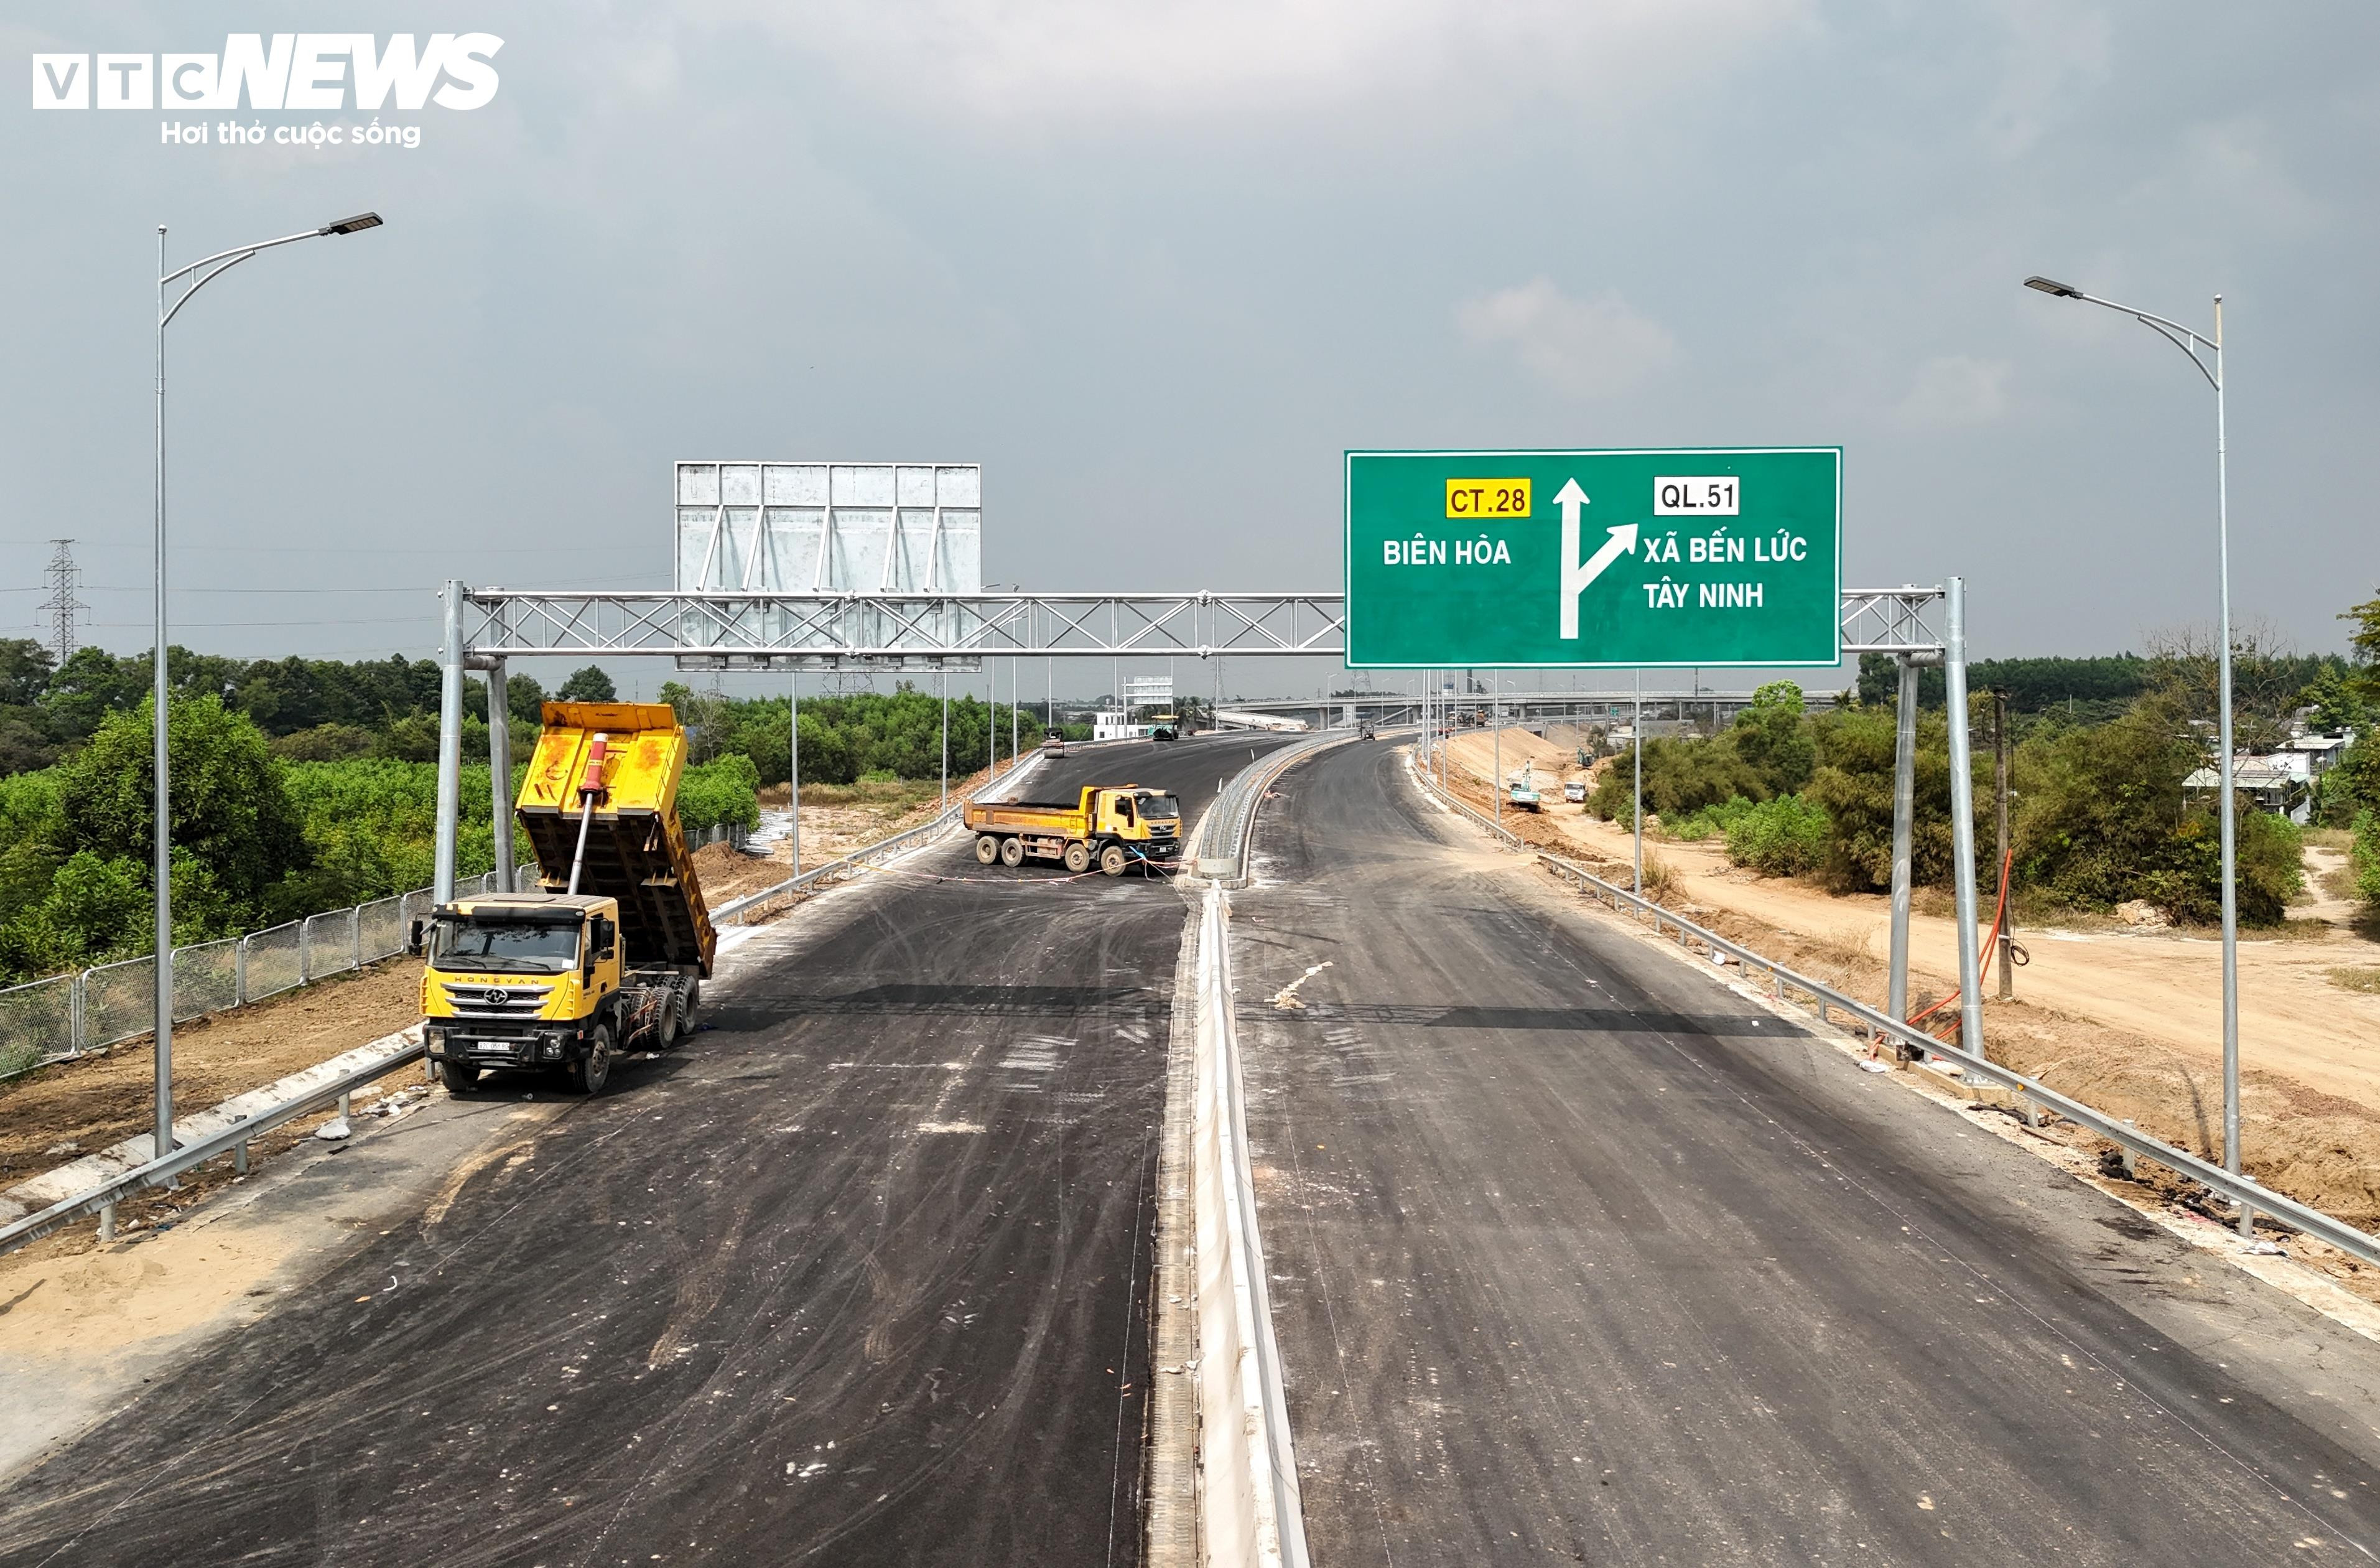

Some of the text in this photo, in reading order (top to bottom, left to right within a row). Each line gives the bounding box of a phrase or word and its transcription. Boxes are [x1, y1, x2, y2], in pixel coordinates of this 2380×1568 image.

[1451, 488, 1525, 513] CT.28
[1662, 483, 1734, 509] QL.51
[1383, 533, 1511, 565] BIÊN HÒA
[1643, 526, 1807, 563] XÃ BẾN LỨC
[1643, 576, 1764, 609] TÂY NINH
